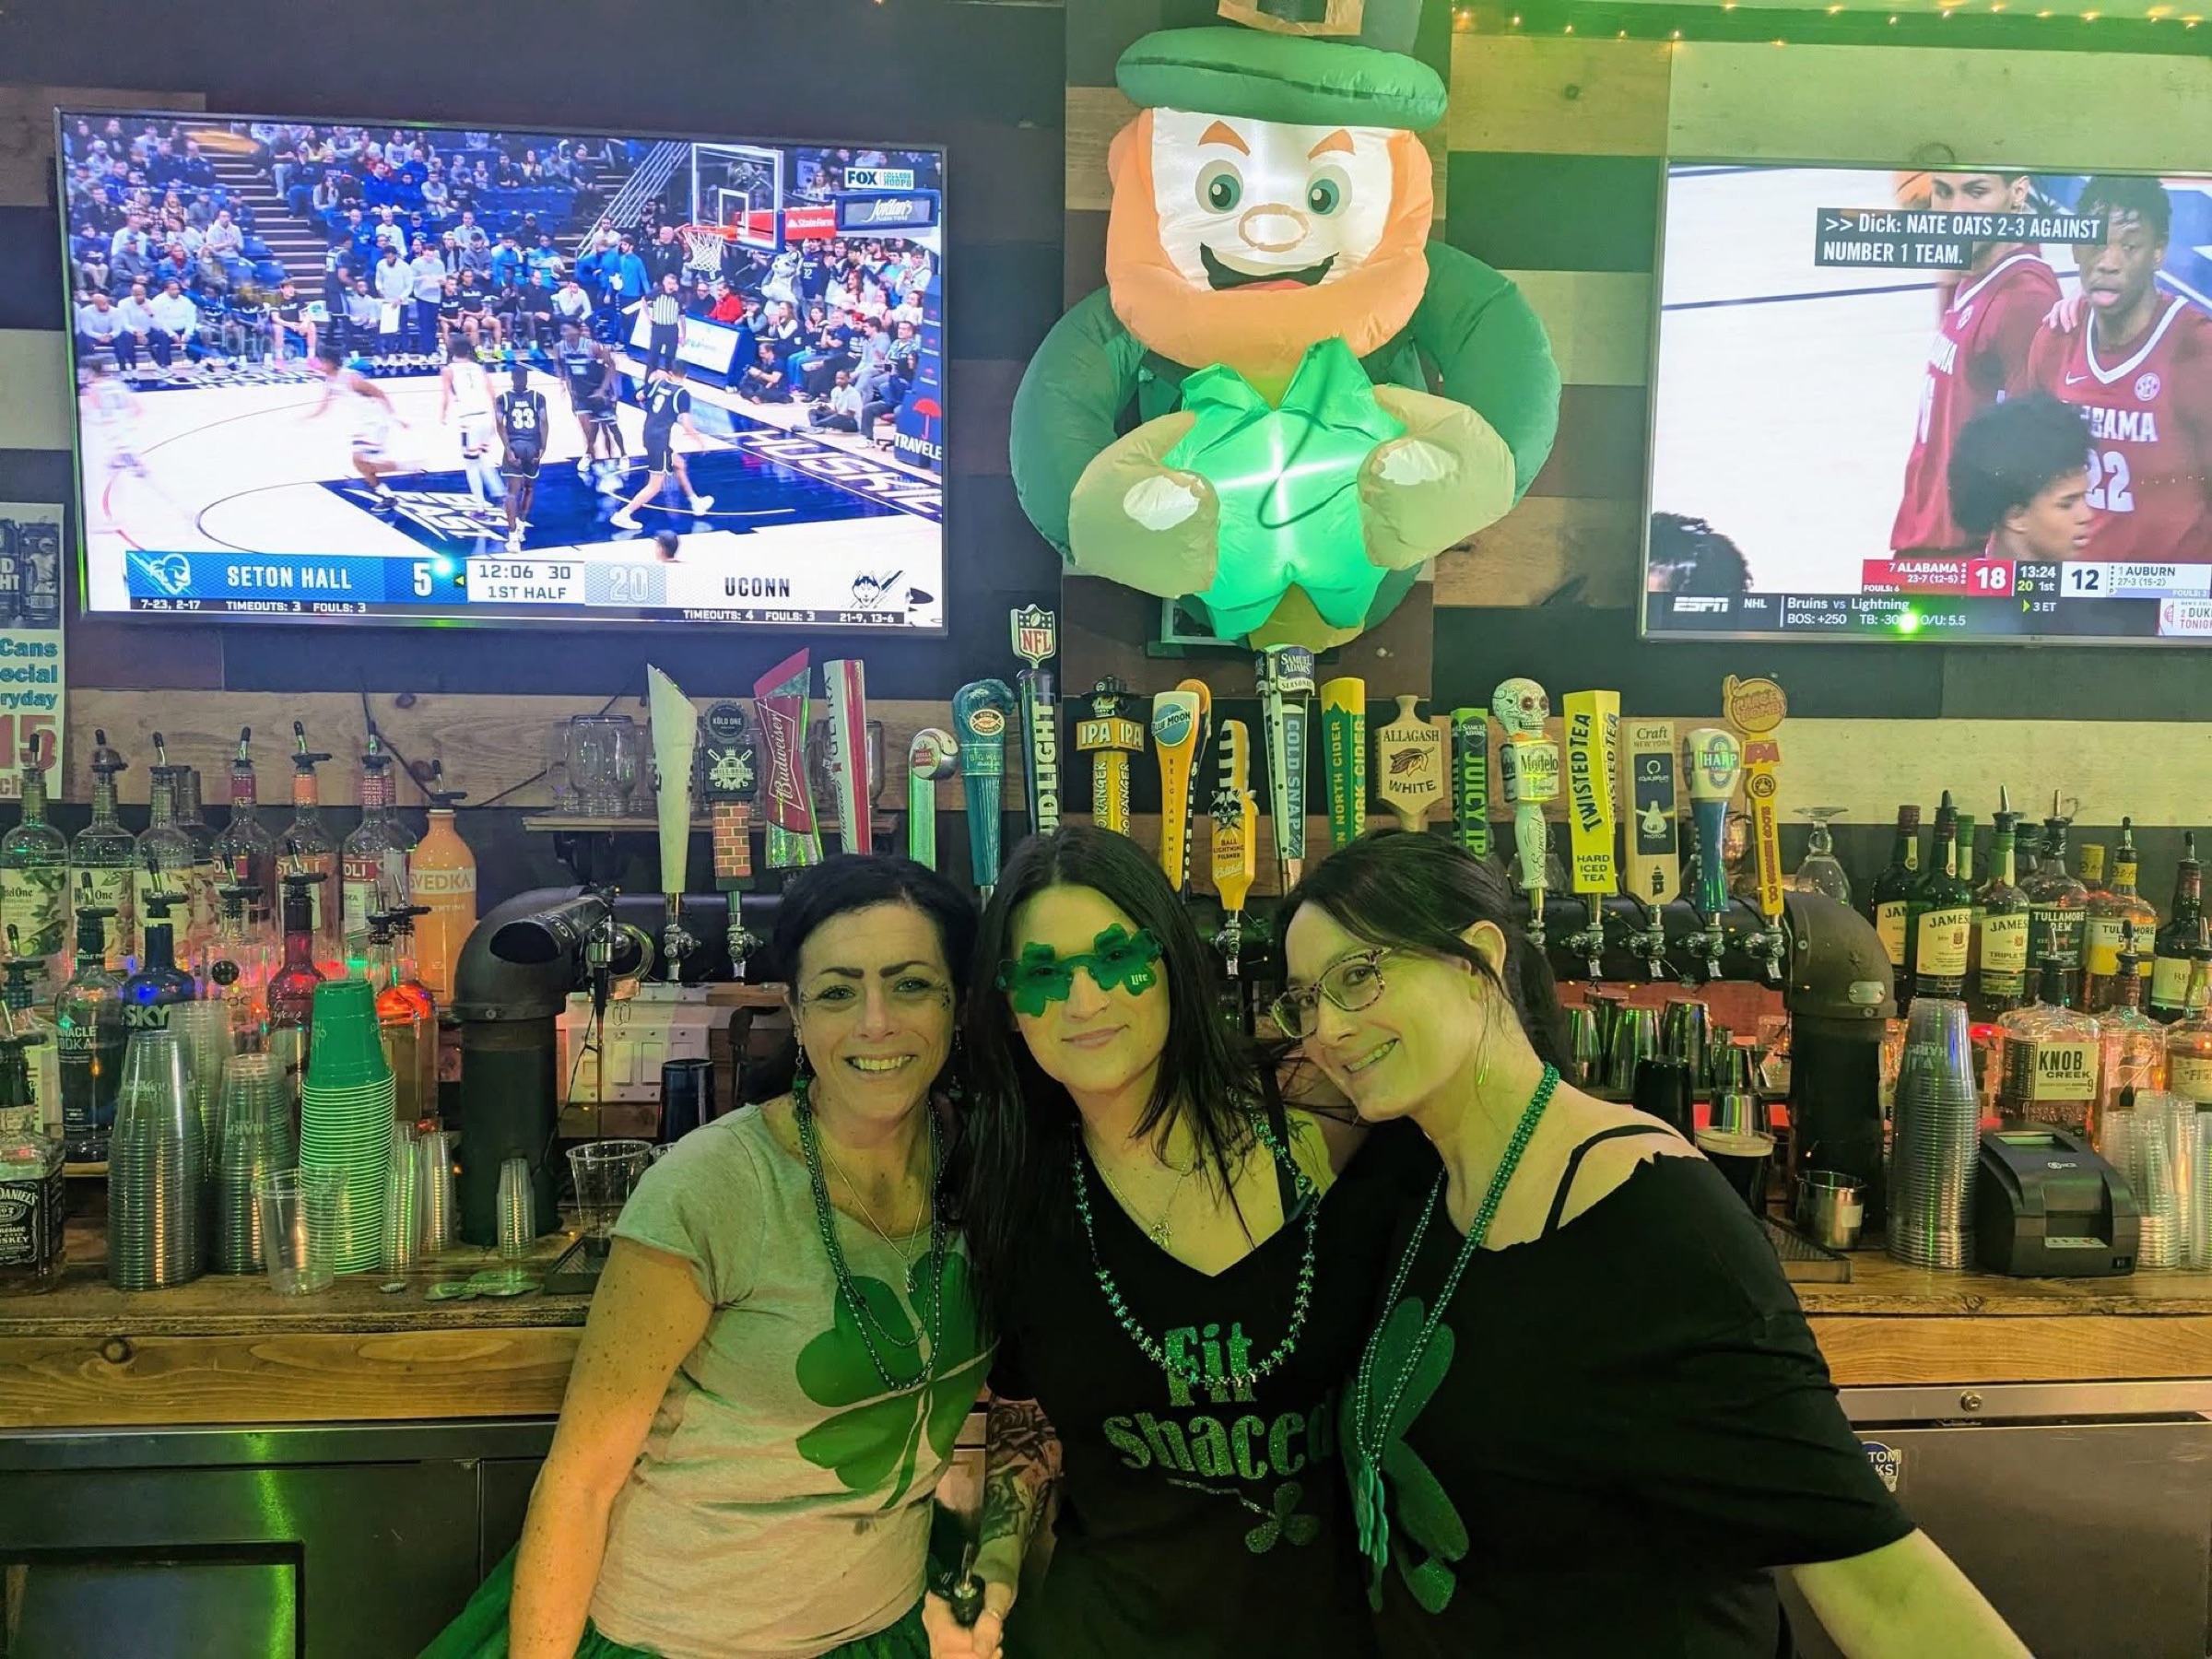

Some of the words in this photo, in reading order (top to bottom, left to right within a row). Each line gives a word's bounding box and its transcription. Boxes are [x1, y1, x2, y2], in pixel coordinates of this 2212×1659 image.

[847, 171, 877, 185] FOX
[1859, 213, 1901, 233] Dick:
[1907, 215, 1947, 234] NATE
[1952, 217, 1992, 236] OATS
[1997, 218, 2025, 237] 2-3
[2029, 219, 2100, 239] AGAINST
[1823, 241, 1894, 263] NUMBER
[1900, 243, 1908, 262] 1
[1915, 244, 1963, 264] TEAM.
[512, 408, 535, 429] 33
[2080, 406, 2159, 441] BAMA
[479, 564, 534, 579] 12:06
[547, 566, 571, 580] 30
[1897, 562, 1959, 573] ALABAMA
[2020, 566, 2056, 578] 13:24
[2126, 567, 2176, 577] AUBURN
[227, 566, 293, 588] SETON
[301, 567, 352, 590] HALL
[413, 562, 433, 597] 5
[609, 566, 649, 602] 20
[1907, 574, 1927, 583] 23-7
[1929, 574, 1959, 584] (12-5)
[1975, 567, 2006, 590] 18
[2018, 581, 2034, 591] 20
[2039, 582, 2055, 592] 1st
[2071, 569, 2099, 591] 12
[2118, 578, 2136, 586] 27-3
[2138, 578, 2167, 587] (15-2)
[488, 586, 519, 598] 1ST
[524, 587, 567, 599] HALF
[724, 577, 790, 597] UCONN
[1864, 584, 1892, 593] FOULS:
[141, 599, 172, 610] 7-23,
[176, 600, 201, 610] 2-17
[226, 600, 288, 612] TIMEOUTS:
[292, 602, 301, 612] 3
[313, 603, 353, 614] FOULS:
[357, 603, 366, 613] 3
[1673, 597, 1729, 613] ESPN
[1743, 598, 1768, 609] NHL
[1787, 597, 1828, 610] Bruins
[1832, 601, 1846, 610] vs
[1851, 598, 1910, 614] Lightning
[2033, 603, 2040, 611] 3
[2042, 603, 2057, 612] ET
[683, 609, 742, 620] TIMEOUTS:
[745, 610, 754, 620] 4
[765, 611, 803, 621] FOULS:
[806, 611, 815, 621] 3
[870, 613, 894, 623] 13-6
[1787, 613, 1816, 625] BOS:
[1817, 615, 1847, 626] +250
[1859, 614, 1878, 625] TB:
[1947, 616, 1966, 626] 5.5
[0, 639, 58, 658] Cans
[1022, 629, 1052, 655] NFL
[1281, 653, 1312, 666] SAMUEL
[1284, 663, 1311, 674] ADAMS
[1167, 711, 1191, 726] MOON
[1080, 722, 1112, 745] IPA
[1119, 722, 1143, 747] IPA
[1382, 729, 1440, 743] ALLAGASH
[1569, 713, 1592, 748] TEA
[1606, 712, 1620, 748] TEA
[1636, 725, 1668, 739] Craft
[1034, 700, 1057, 790] LIGHT
[1287, 719, 1301, 767] COLD
[1331, 720, 1343, 768] CIDER
[1354, 720, 1365, 778] CIDER
[771, 710, 794, 806] Budweiser
[1521, 751, 1559, 771] Modelo
[1703, 753, 1737, 767] HARP
[1095, 760, 1107, 817] RANGER
[1118, 762, 1130, 817] RANGER
[1388, 779, 1437, 794] WHITE
[1464, 750, 1487, 822] JUICY
[1571, 750, 1604, 833] TWISTED
[1287, 776, 1302, 830] SNAP
[1333, 772, 1346, 826] NORTH
[1355, 784, 1365, 838] YORK
[1168, 836, 1176, 872] WHIT
[1577, 854, 1610, 864] HARD
[1580, 865, 1608, 873] ICED
[409, 873, 471, 891] SVEDKA
[1582, 874, 1606, 882] TEA
[15, 888, 33, 898] One
[95, 889, 112, 900] One
[2033, 912, 2086, 922] TULLAMORE
[2038, 1050, 2083, 1071] KNOB
[2087, 1078, 2094, 1093] 9
[1164, 1322, 1258, 1406] Fit
